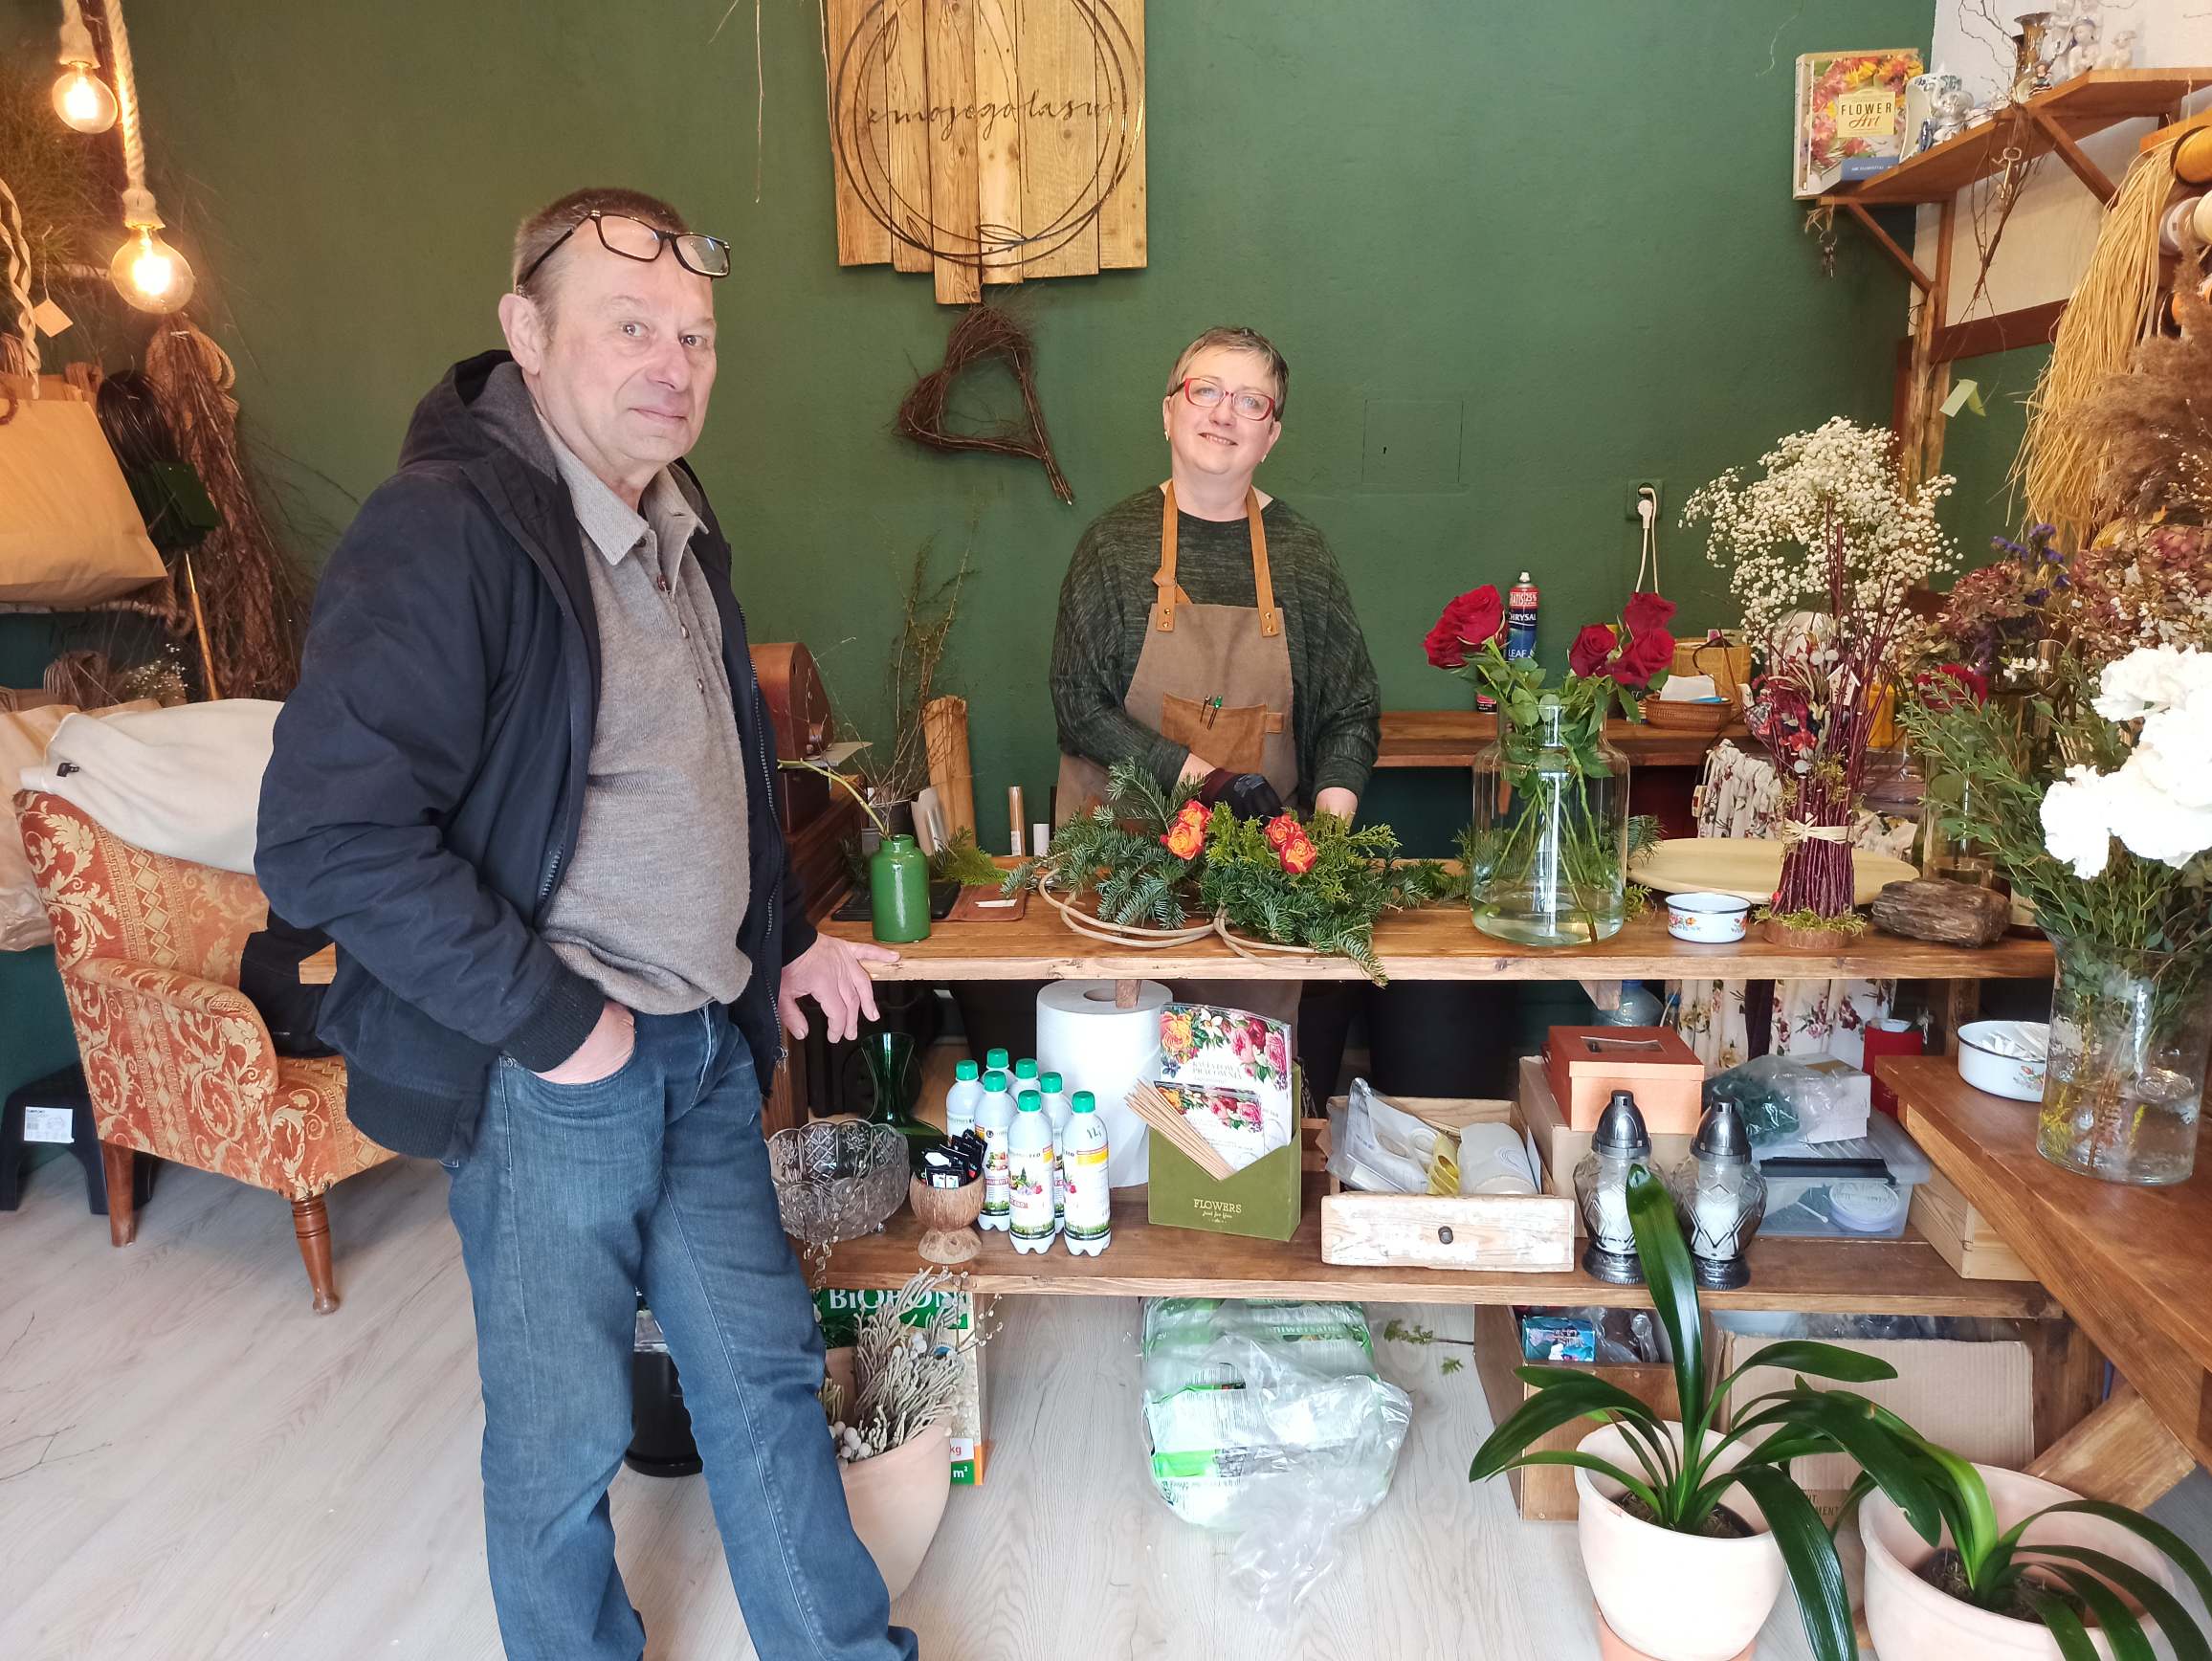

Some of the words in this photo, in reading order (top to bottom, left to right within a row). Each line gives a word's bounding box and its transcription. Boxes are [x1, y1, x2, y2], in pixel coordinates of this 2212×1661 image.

[1841, 101, 1892, 116] FLOWER
[1848, 113, 1881, 129] Art
[1509, 649, 1527, 658] LEAF
[1194, 1198, 1242, 1213] FLOWERS
